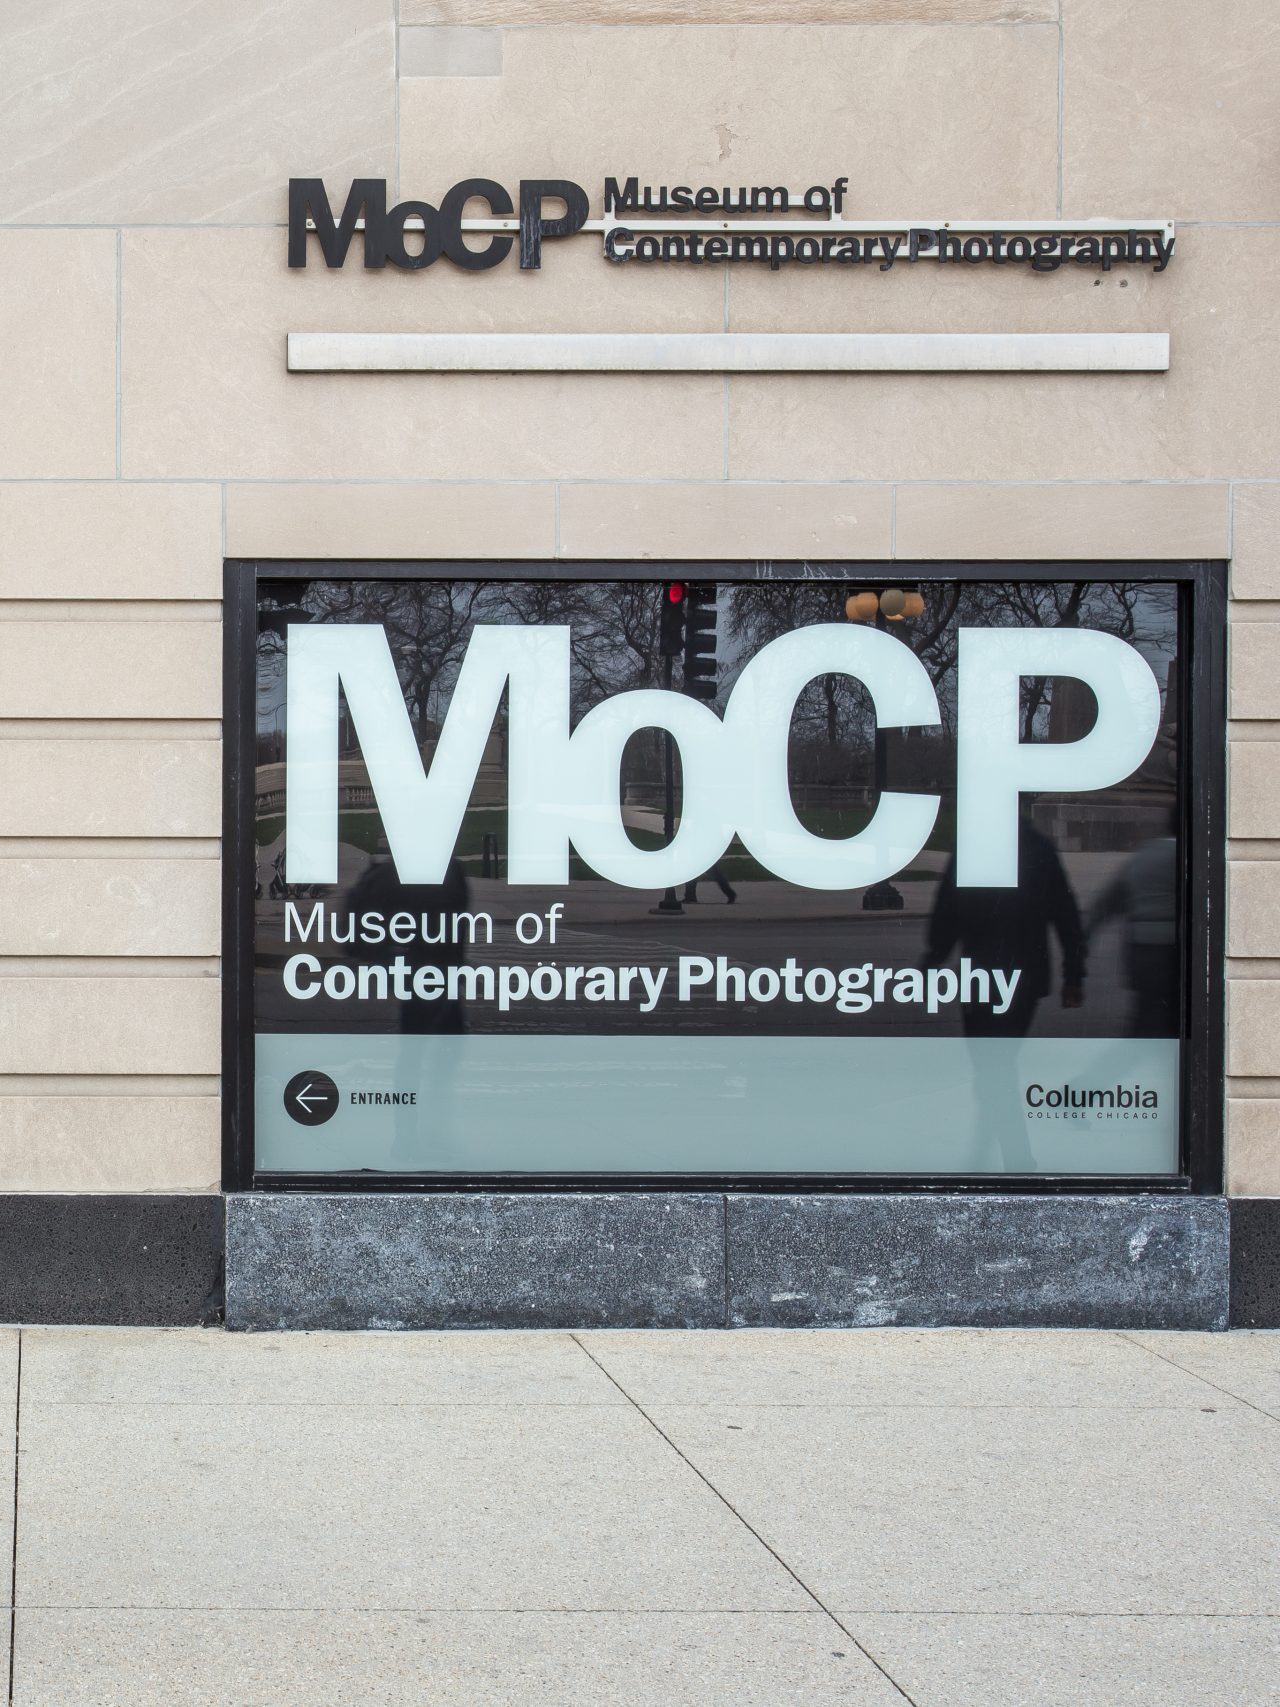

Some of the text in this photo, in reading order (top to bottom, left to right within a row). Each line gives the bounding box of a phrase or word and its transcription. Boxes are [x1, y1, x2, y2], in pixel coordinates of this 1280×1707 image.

[604, 177, 849, 213] Museum of
[287, 177, 590, 271] MoCP
[605, 227, 1176, 272] Contemporary Photography
[286, 623, 1162, 891] MoCP
[284, 902, 564, 945] Museum of
[678, 956, 1022, 1014] Photography
[350, 1092, 417, 1105] ENTRANCE
[1025, 1083, 1159, 1109] Columbia
[1027, 1111, 1159, 1120] COLLEGE CHICAGO
